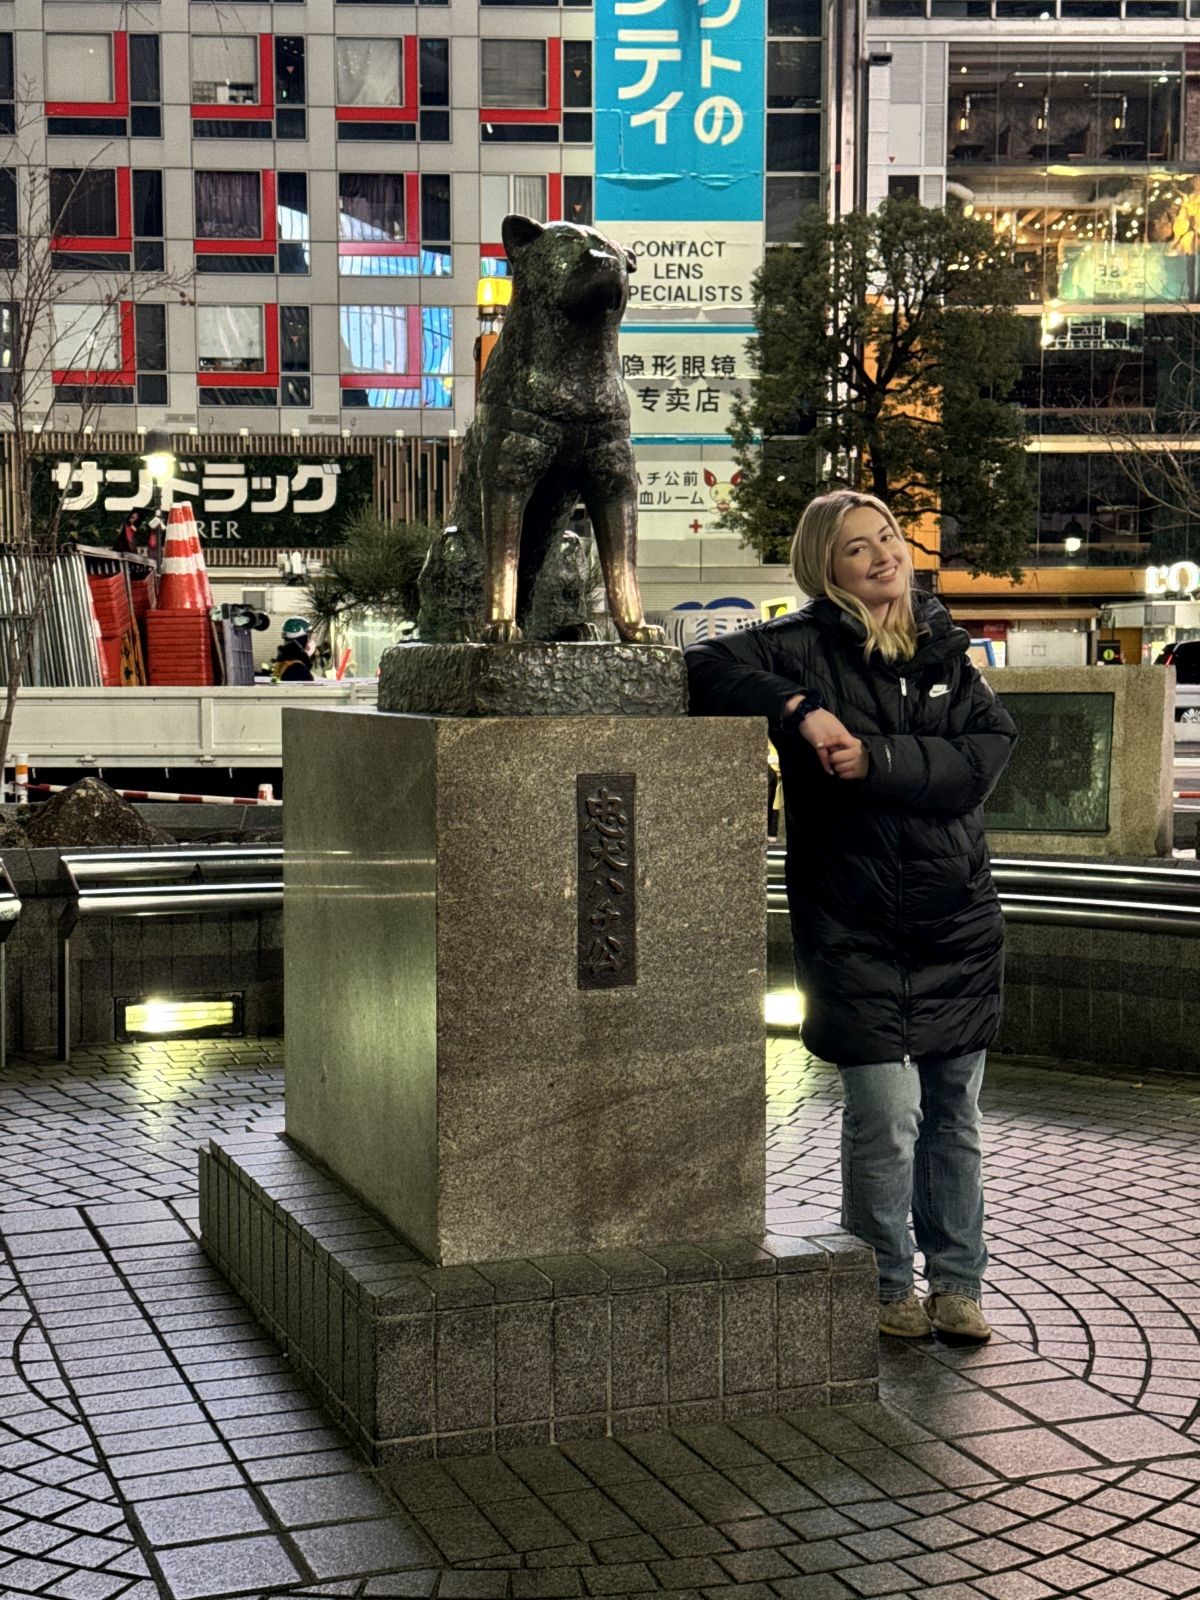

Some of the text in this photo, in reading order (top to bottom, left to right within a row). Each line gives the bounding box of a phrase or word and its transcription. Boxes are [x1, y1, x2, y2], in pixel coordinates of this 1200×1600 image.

[614, 0, 685, 145] ティ
[632, 240, 727, 258] CONTACT
[653, 263, 704, 280] LENS
[628, 285, 743, 303] PECIALISTS
[622, 354, 737, 380] 隐形眼镜
[636, 386, 721, 413] 专卖店
[51, 460, 342, 514] サンドラッグ
[639, 490, 705, 506] 血ルーム
